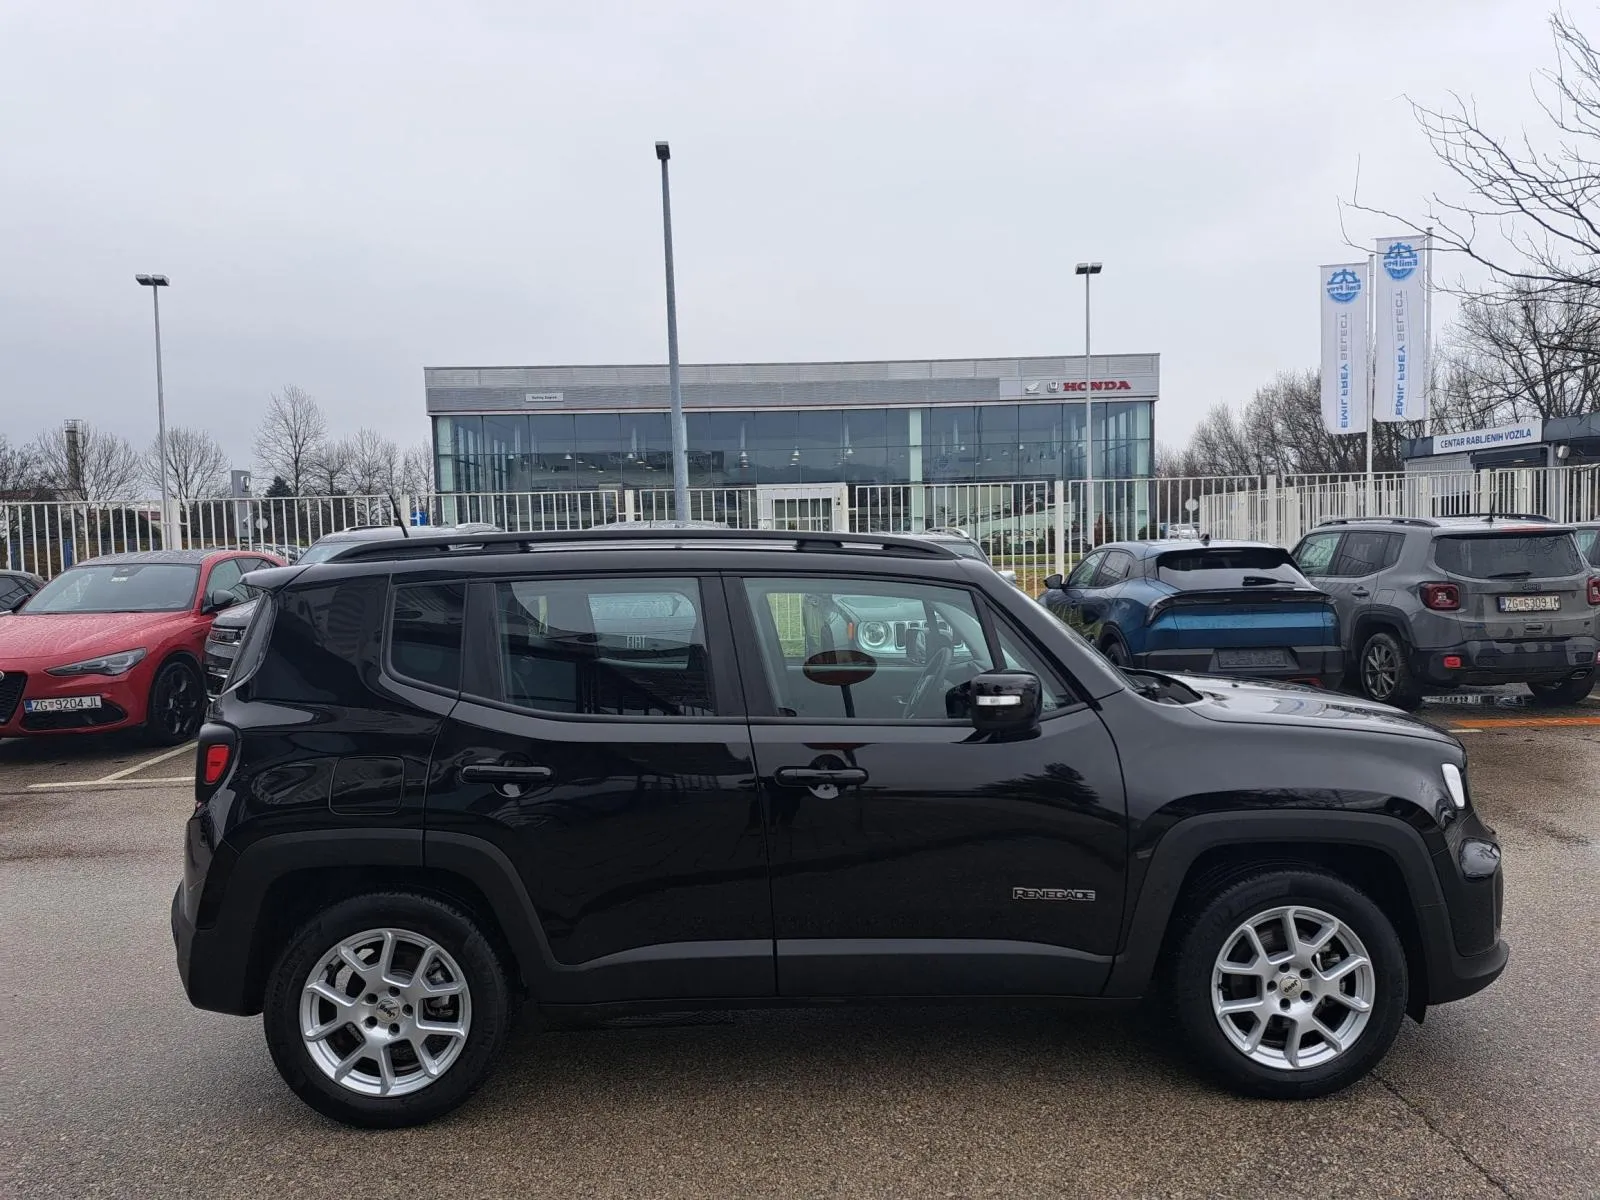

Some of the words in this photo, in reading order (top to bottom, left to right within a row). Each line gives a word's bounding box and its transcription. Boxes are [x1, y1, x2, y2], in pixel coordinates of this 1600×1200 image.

[1063, 380, 1132, 392] HONDA
[1440, 437, 1465, 449] CENTAR
[1466, 432, 1504, 445] RABLJENIH
[1504, 428, 1532, 440] VOZILA
[1507, 598, 1519, 609] ZG
[626, 635, 646, 649] FIAT
[33, 700, 48, 711] ZG
[1012, 886, 1096, 901] RENEGADE
